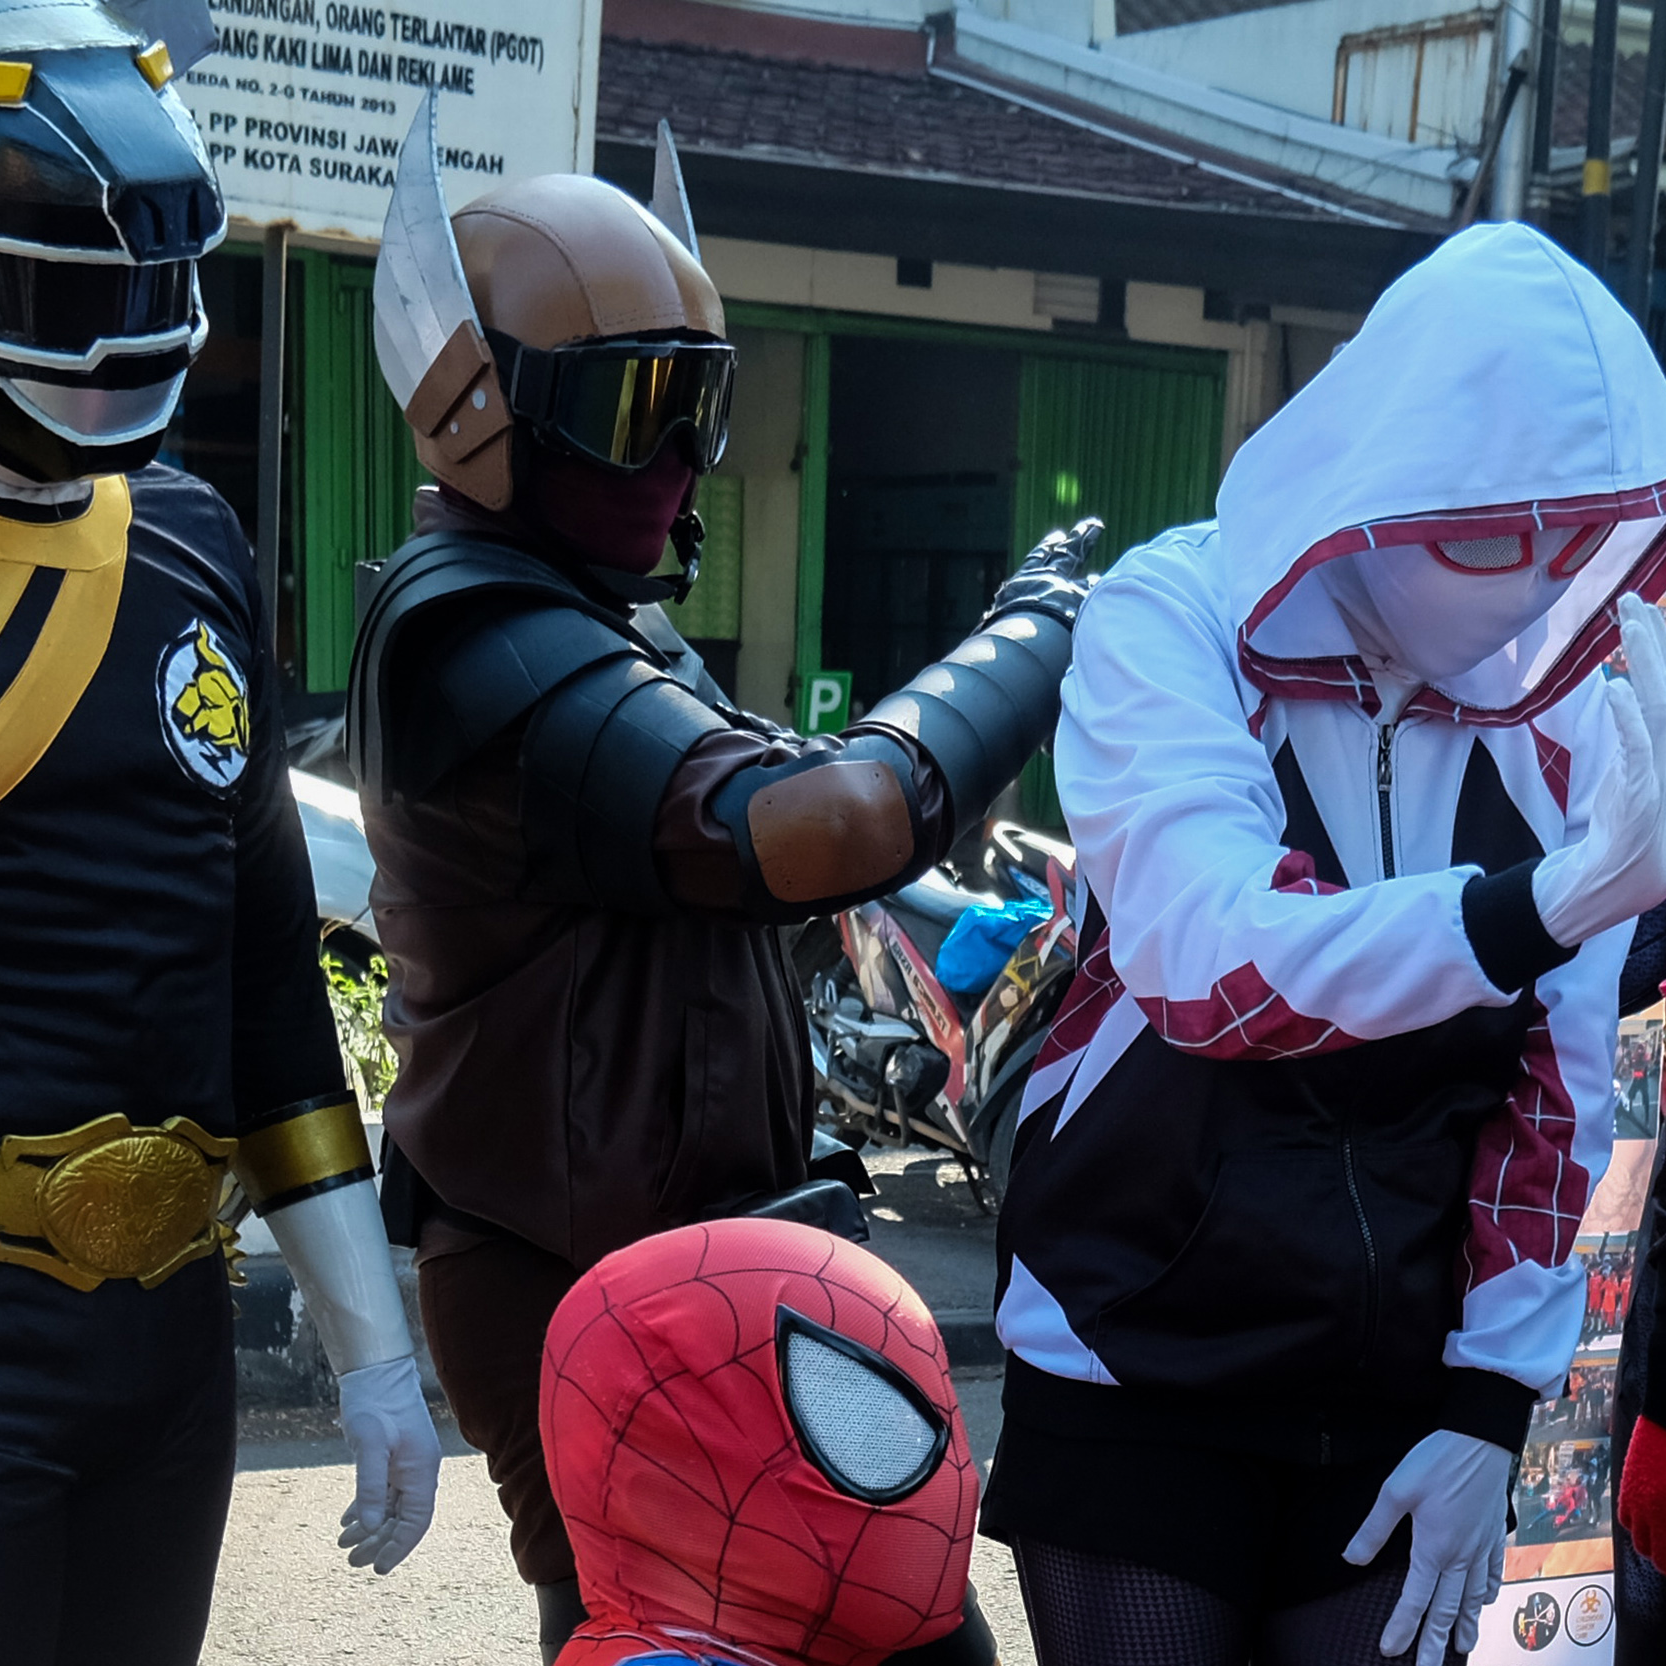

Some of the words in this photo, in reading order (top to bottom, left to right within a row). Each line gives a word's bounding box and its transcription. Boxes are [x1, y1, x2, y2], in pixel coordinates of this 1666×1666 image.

[264, 34, 307, 67] KAKI
[312, 42, 353, 75] LIMA
[358, 49, 392, 82] DAN
[326, 2, 385, 38] ORANG
[390, 12, 486, 57] TERLANTAR
[490, 30, 544, 74] (PGOT)
[186, 71, 230, 89] ERDA
[236, 78, 264, 95] NO.
[300, 87, 355, 107] TAHUN
[361, 96, 396, 116] 2013
[209, 111, 238, 135] PP
[244, 116, 346, 150] PROVINSI
[353, 133, 399, 159] JAW
[436, 146, 504, 175] ENGAH
[209, 141, 237, 165] PP
[244, 147, 302, 175] KOTA
[309, 157, 397, 189] SURAKA
[808, 679, 842, 731] P
